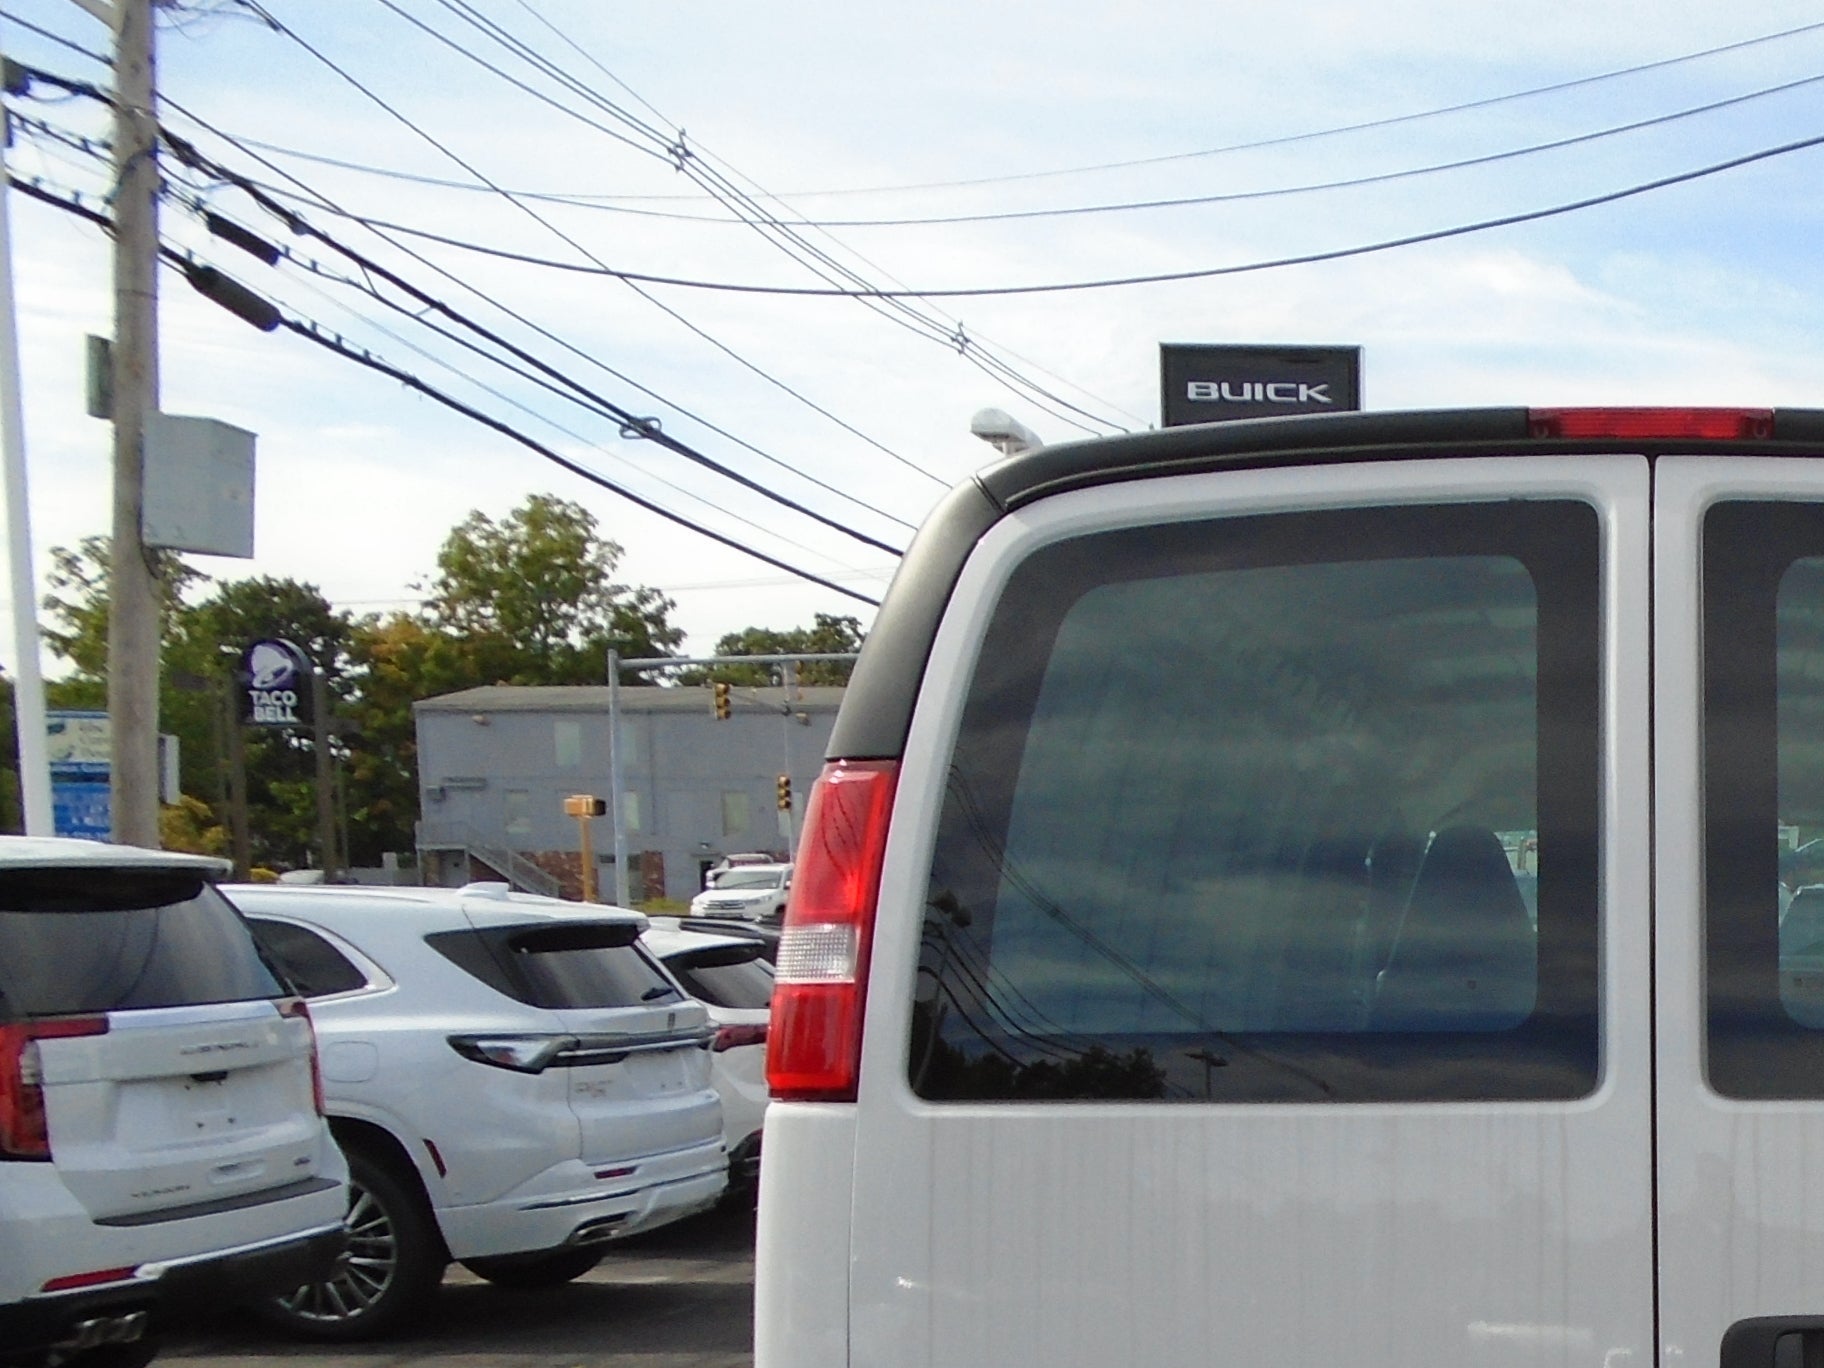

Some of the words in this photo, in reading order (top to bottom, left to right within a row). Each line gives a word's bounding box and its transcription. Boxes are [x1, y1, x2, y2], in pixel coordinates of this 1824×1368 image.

[1187, 381, 1333, 404] BUICK
[247, 690, 297, 707] TACO
[254, 706, 298, 722] BELL
